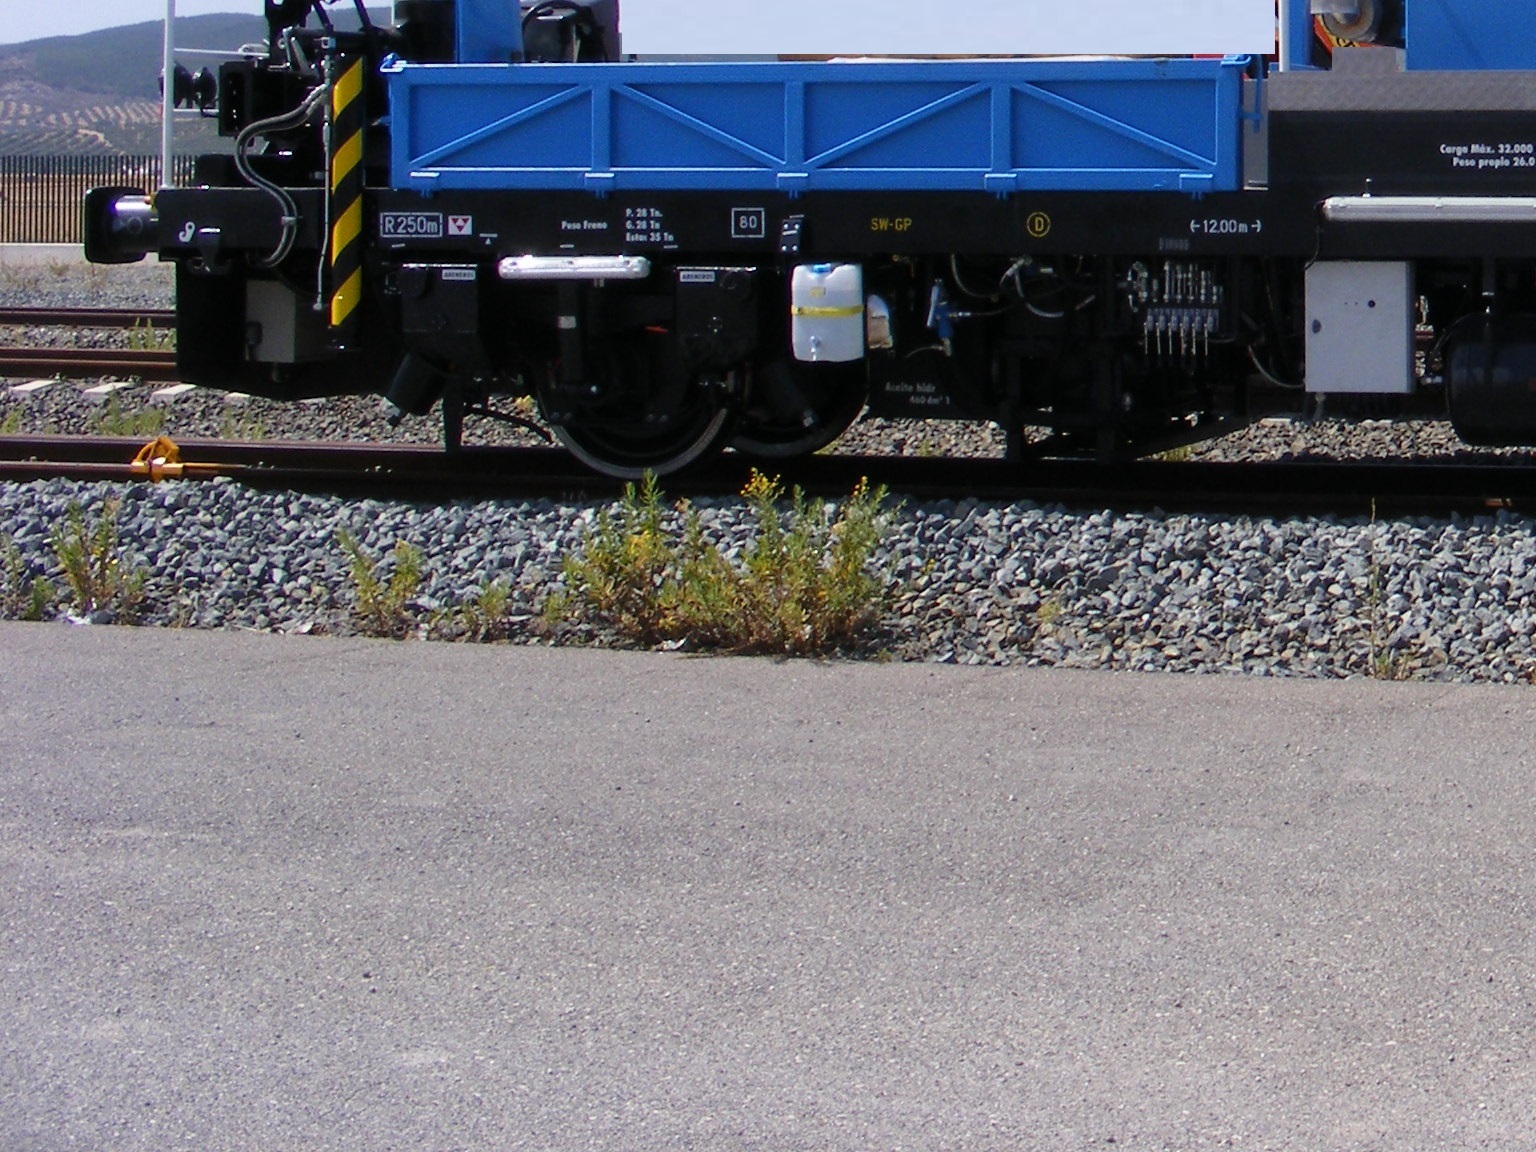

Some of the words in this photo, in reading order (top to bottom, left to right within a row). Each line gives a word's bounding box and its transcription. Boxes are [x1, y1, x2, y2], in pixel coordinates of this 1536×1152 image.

[1440, 144, 1468, 156] Carga
[1498, 144, 1534, 154] 32.000
[1453, 157, 1476, 166] Peso
[1478, 156, 1511, 169] propio
[1512, 157, 1536, 167] 26.0
[385, 217, 395, 233] R
[397, 217, 438, 233] 250m
[739, 215, 758, 229] 80
[870, 218, 912, 231] SW-GP
[1034, 217, 1044, 232] D
